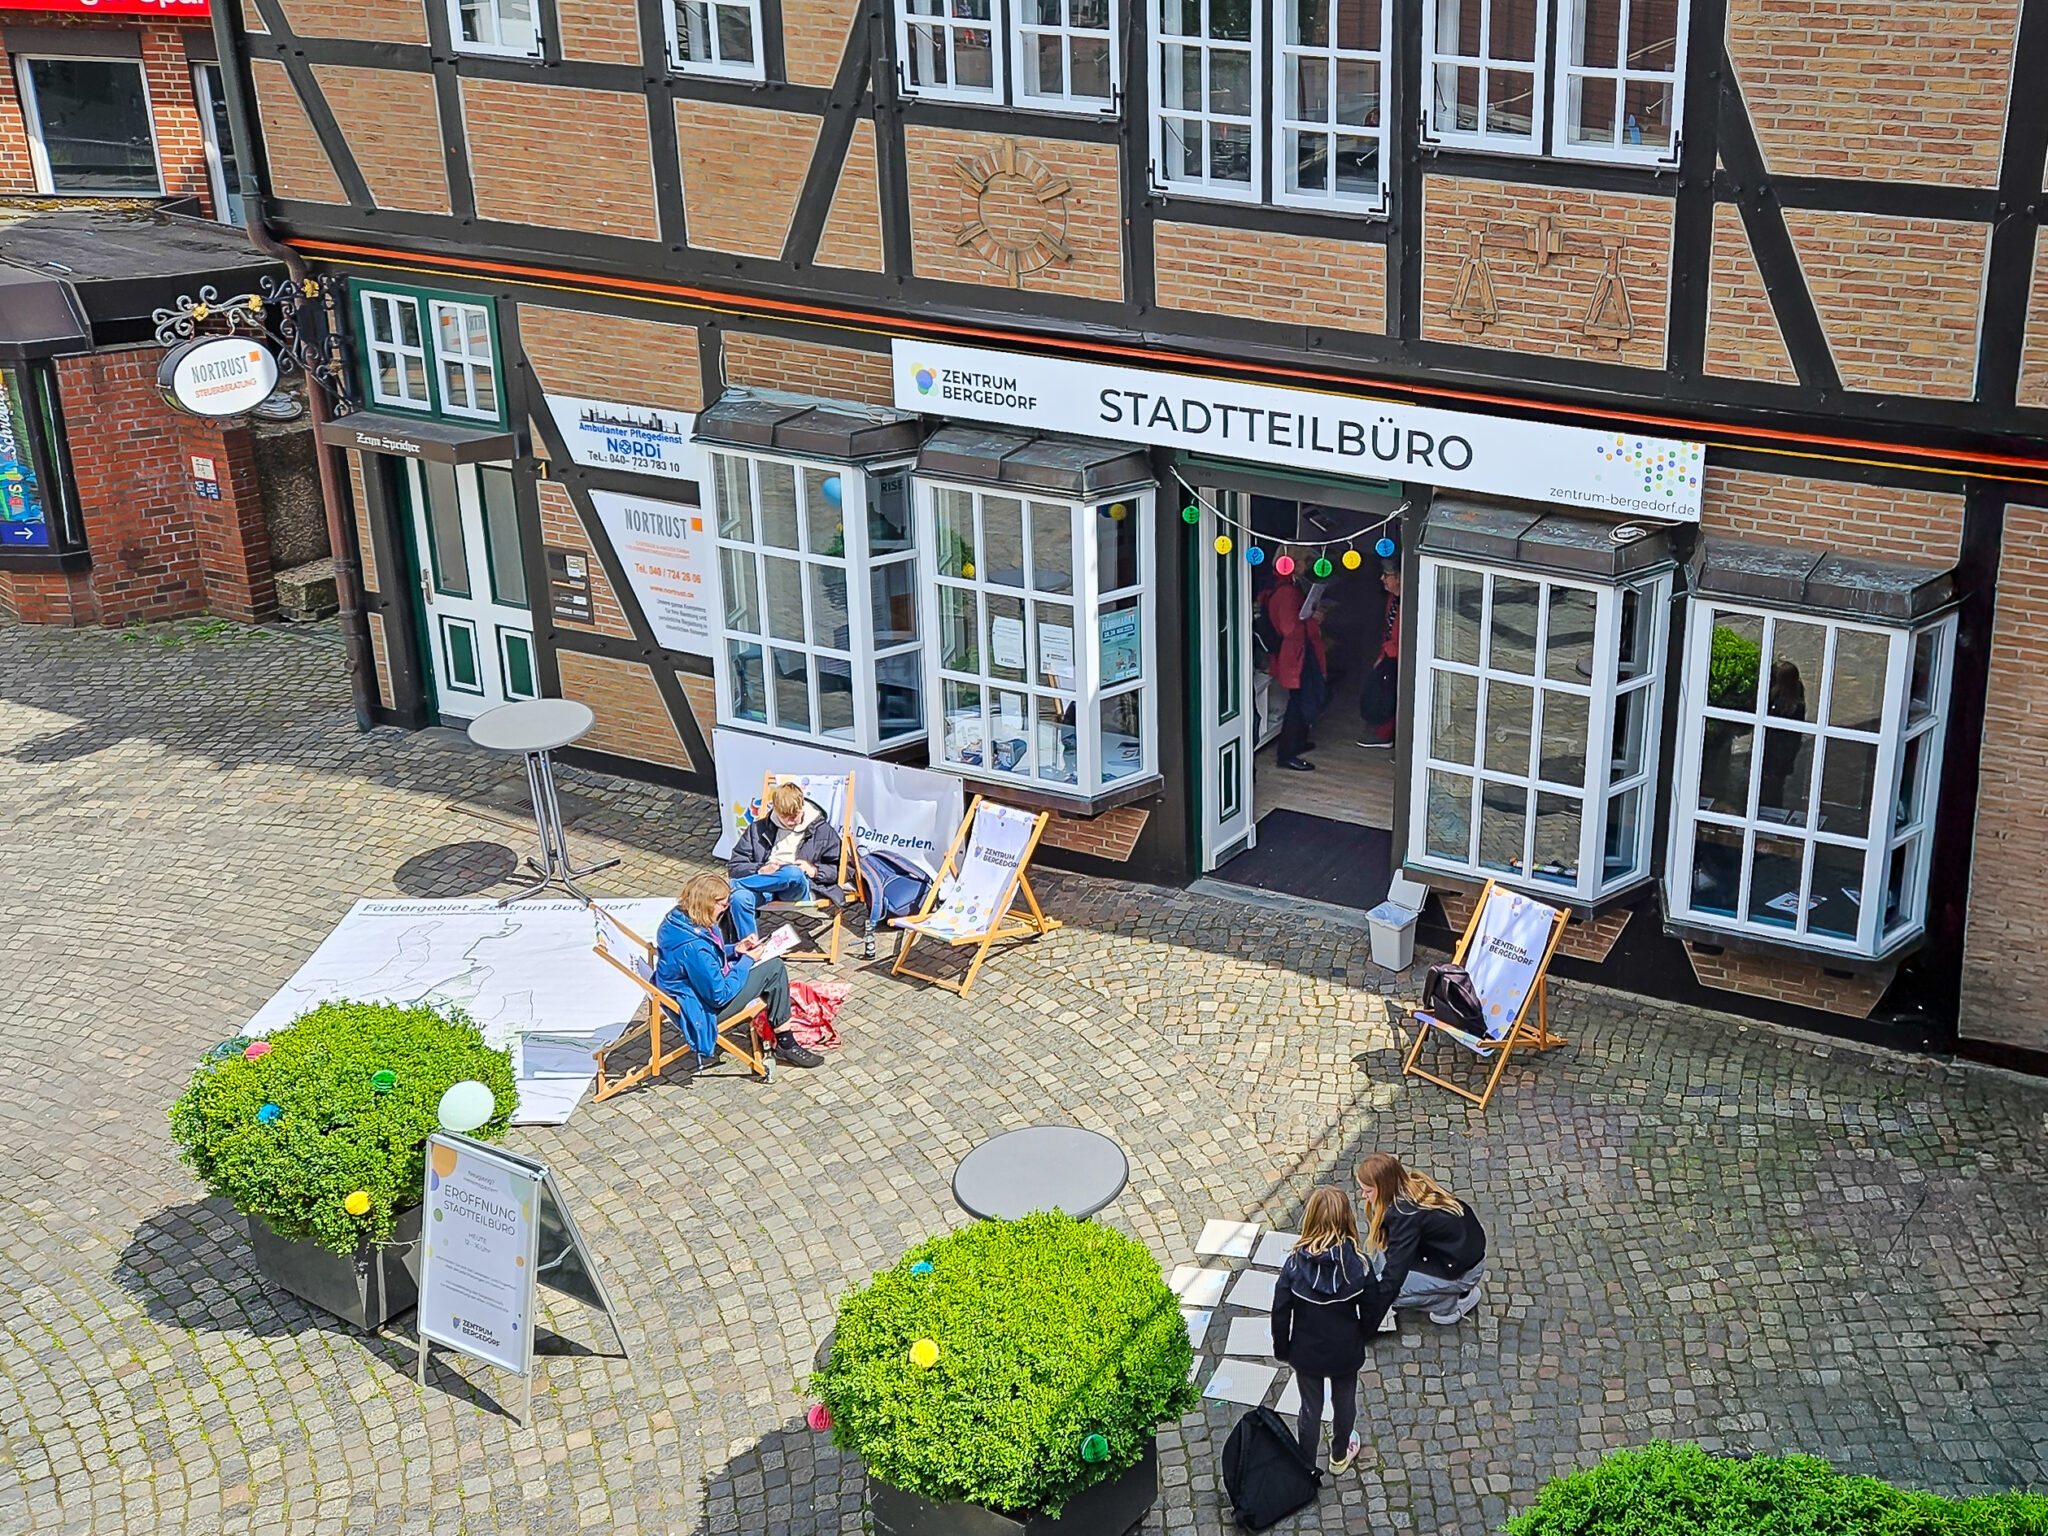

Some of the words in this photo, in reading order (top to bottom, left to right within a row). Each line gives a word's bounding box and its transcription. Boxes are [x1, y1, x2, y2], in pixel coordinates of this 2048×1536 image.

[191, 356, 249, 384] NORTRUST
[941, 369, 1017, 392] ZENTRUM
[194, 378, 257, 398] STEUERBERATUNG
[942, 385, 1037, 411] BERGEDORF
[579, 422, 628, 436] Ambulanter
[630, 429, 683, 444] Pflegedienst
[1099, 388, 1473, 471] STADTTEILBÜRO
[538, 462, 547, 479] 1
[1549, 486, 1696, 517] zentrum-bergedorf.de
[624, 508, 688, 540] NORTRUST
[855, 825, 890, 845] Deine
[890, 834, 935, 852] Perlen.
[984, 847, 1016, 861] ZENTRUM
[1488, 945, 1534, 966] BERGEDORF
[1491, 937, 1527, 957] ZENTRUM
[444, 1200, 515, 1236] STADTTEILBÜRO
[462, 1319, 493, 1337] ZENTRUM
[462, 1326, 500, 1347] BERGEDORF
